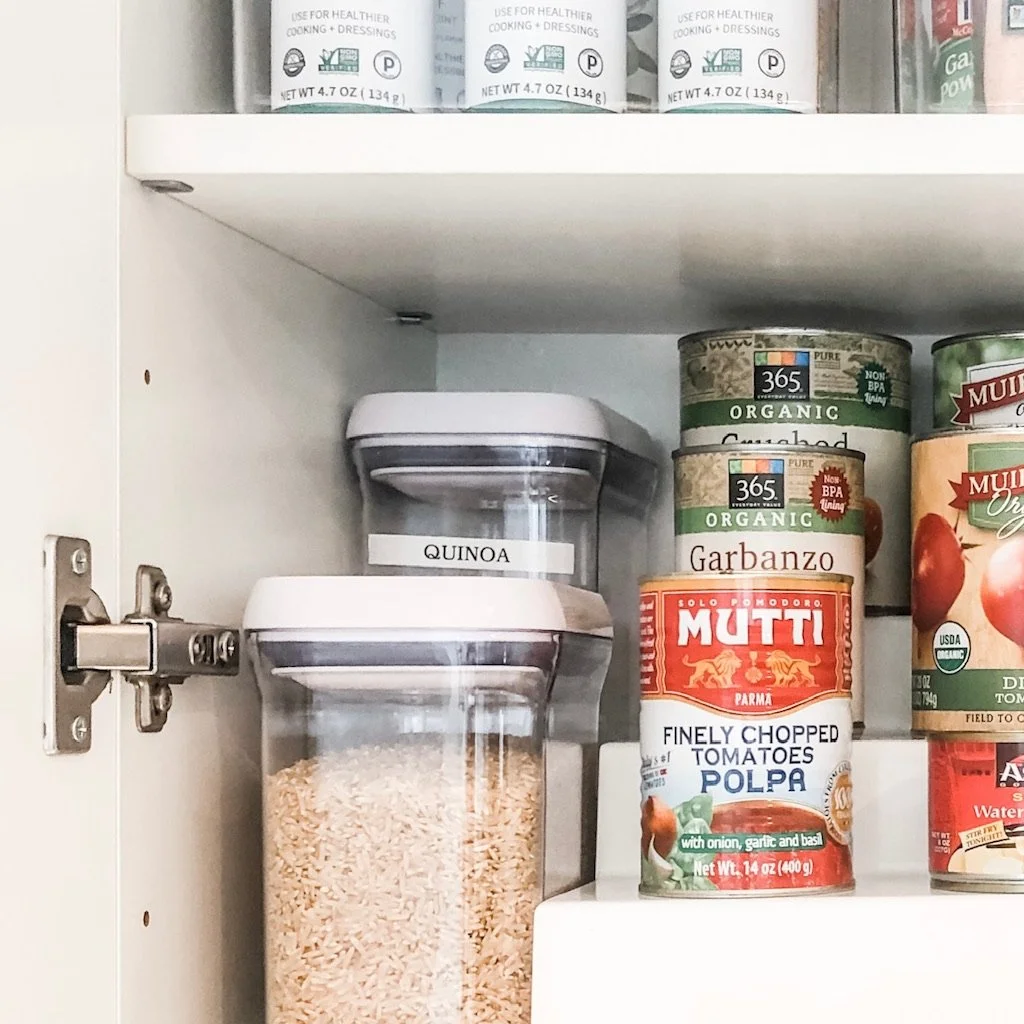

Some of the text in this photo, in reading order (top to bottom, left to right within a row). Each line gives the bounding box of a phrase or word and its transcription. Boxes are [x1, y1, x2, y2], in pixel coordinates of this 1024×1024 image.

[292, 10, 390, 24] USE FOR HEALTHIER
[494, 7, 592, 22] USE FOR HEALTHIER
[678, 10, 774, 23] USE FOR HEALTHIER
[286, 25, 397, 40] COOKING DRESSINGS
[488, 22, 599, 38] COOKING DRESSINGS
[673, 24, 780, 39] COOKING DRESSINGS
[281, 87, 357, 101] NET WT 4.7 OZ
[482, 83, 562, 97] NET WT 4.7 OZ
[668, 86, 742, 104] NET WT 4.7 OZ
[814, 352, 840, 360] PURE
[762, 368, 800, 393] 365
[868, 382, 885, 393] BPA
[864, 393, 887, 407] Lining
[730, 405, 839, 420] ORGANIC
[736, 476, 777, 501] 365
[822, 486, 843, 497] BPA
[820, 499, 845, 513] Lining
[706, 513, 813, 528] ORGANIC
[424, 544, 510, 563] QUINOA
[690, 542, 834, 572] Garbanzo
[678, 599, 821, 608] SOLO POMODORO
[677, 608, 824, 646] MUTTI
[940, 634, 961, 646] USDA
[937, 650, 965, 660] ORGANIC
[735, 692, 772, 706] PARMA
[966, 714, 994, 723] FIELD
[998, 714, 1013, 723] TO
[664, 725, 839, 745] FINELY CHOPPED
[692, 747, 814, 766] TOMATOES
[700, 768, 807, 794] POLPA
[974, 805, 1024, 819] Water
[984, 824, 997, 834] FRY
[682, 832, 824, 852] with onion, garlic and basil
[694, 862, 715, 877] Net
[718, 861, 740, 876] Wt.
[744, 861, 759, 875] 14
[761, 863, 776, 874] oz
